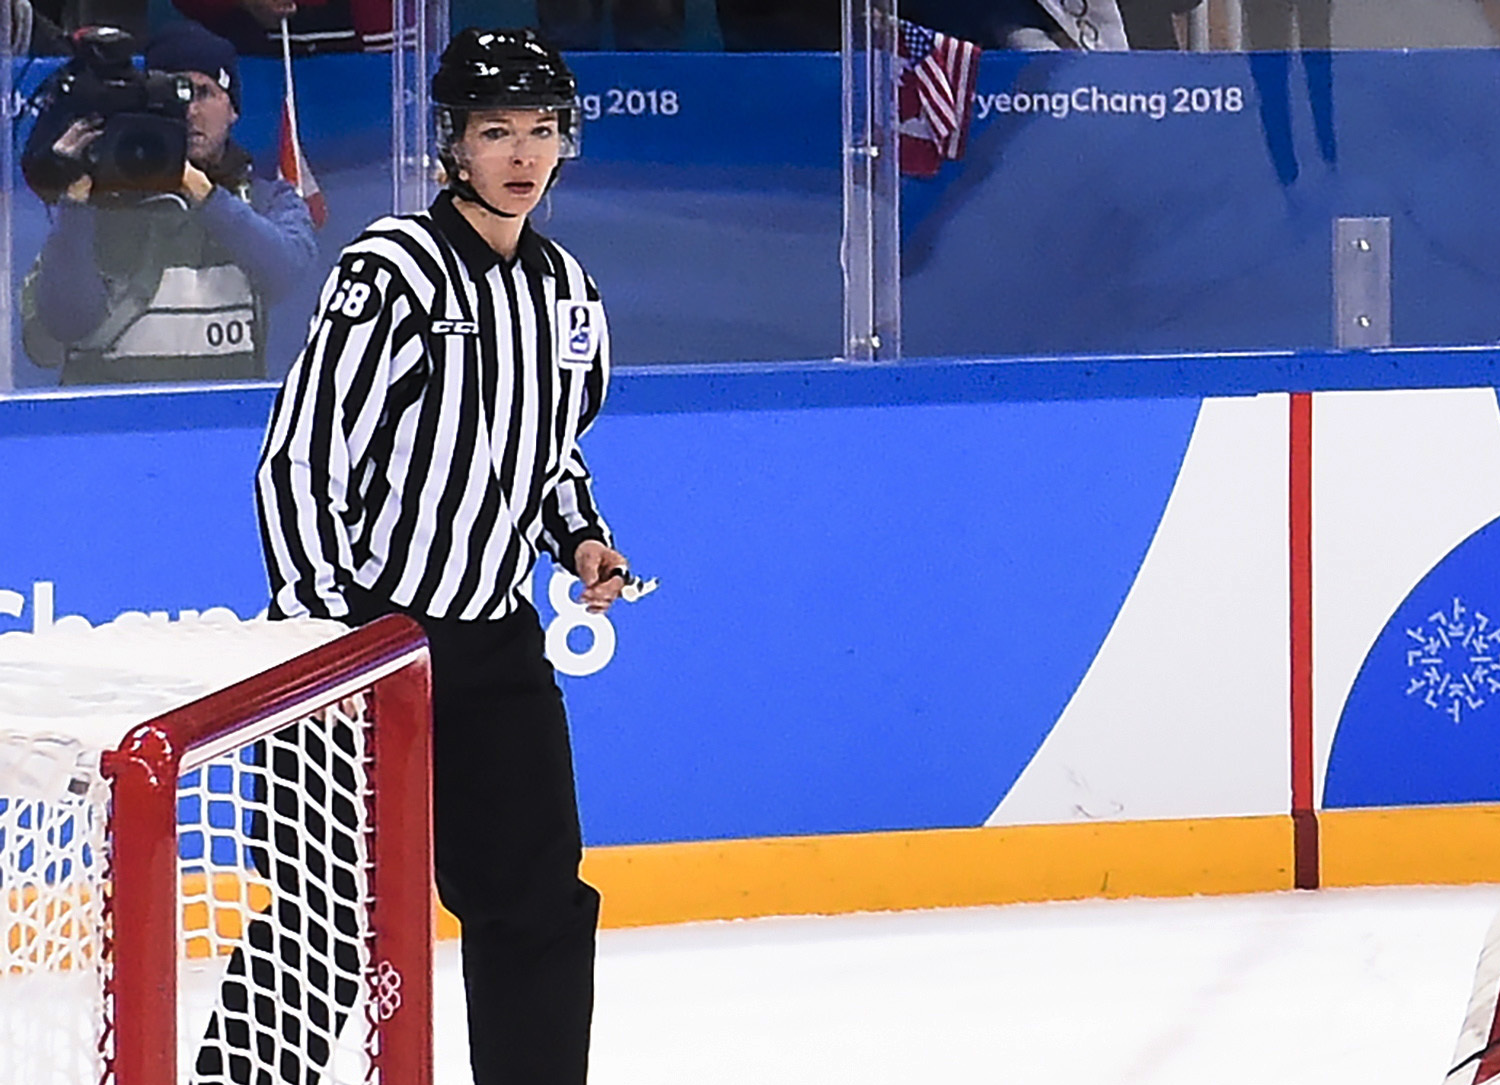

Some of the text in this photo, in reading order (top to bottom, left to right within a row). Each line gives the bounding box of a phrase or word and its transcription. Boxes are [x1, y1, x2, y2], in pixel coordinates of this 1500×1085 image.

[607, 89, 679, 115] 2018
[973, 86, 1243, 119] yeongChang 2018
